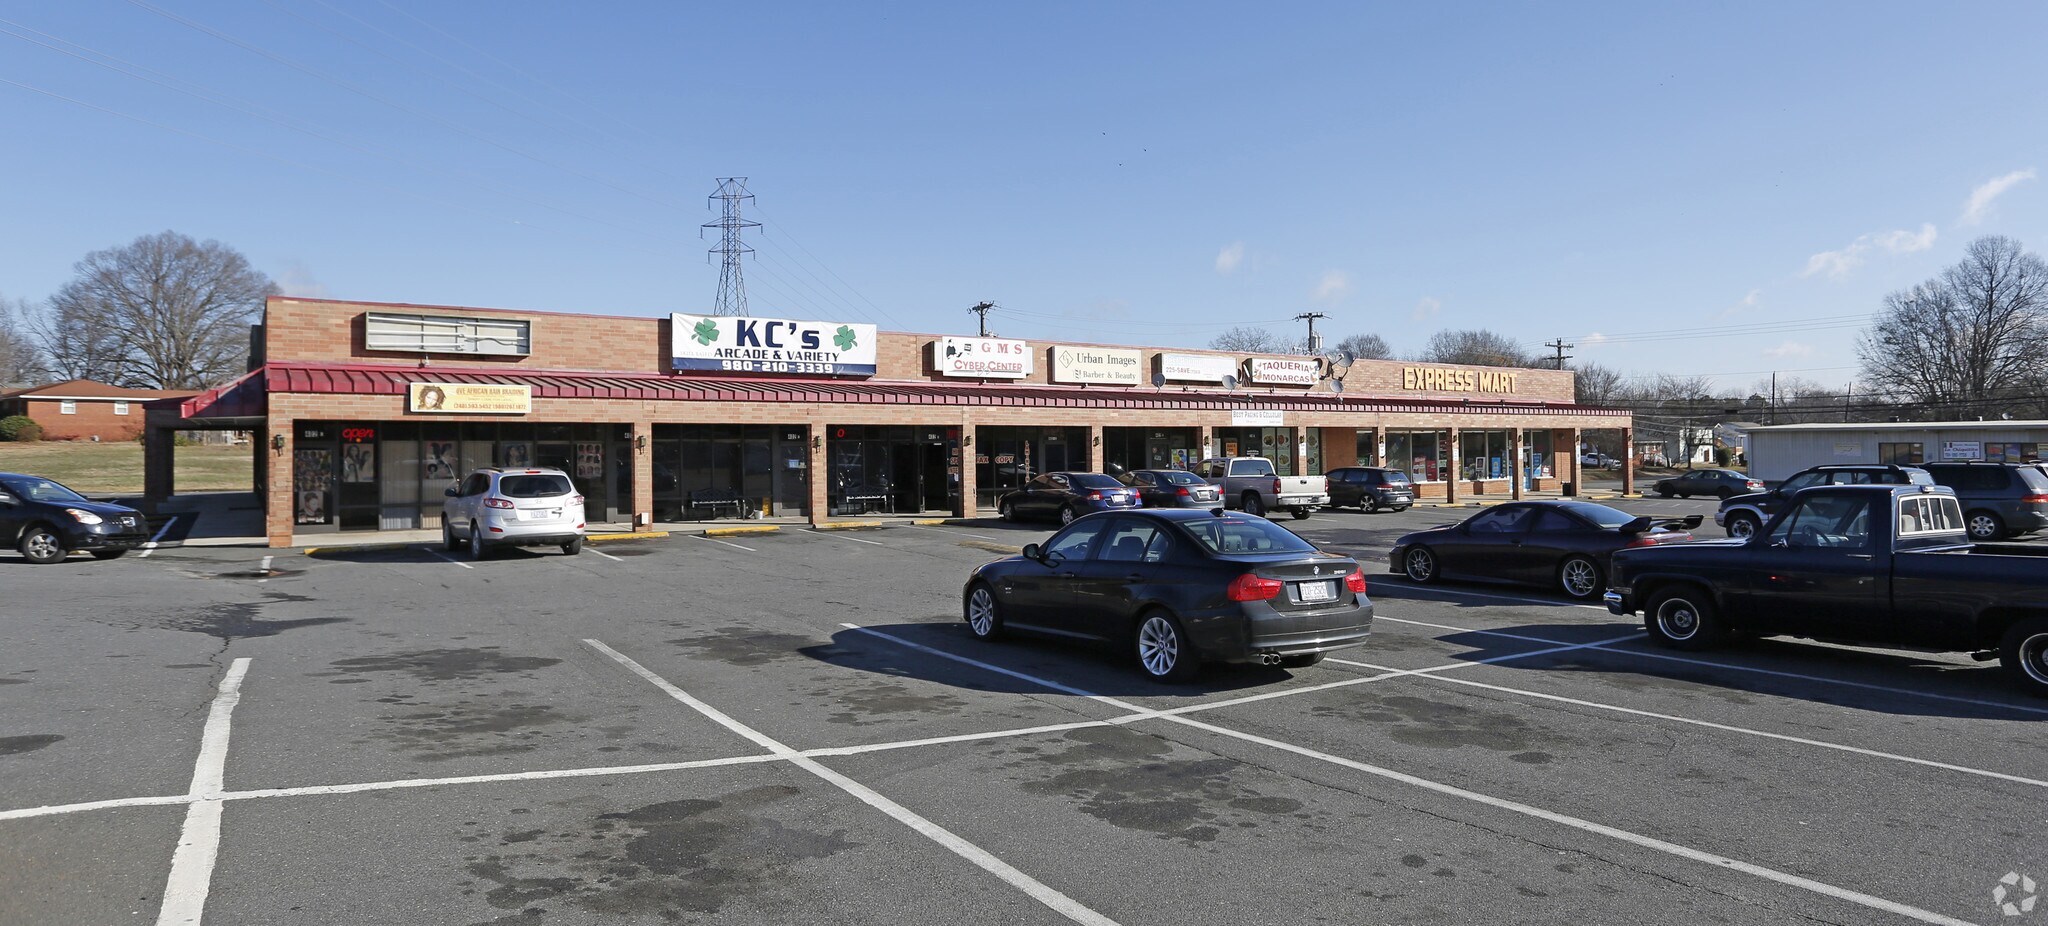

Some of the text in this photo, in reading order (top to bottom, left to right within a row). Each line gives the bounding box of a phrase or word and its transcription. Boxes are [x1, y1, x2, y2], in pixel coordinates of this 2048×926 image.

[736, 319, 820, 350] KC's
[714, 348, 840, 362] ARCADE & VARIETY
[1077, 353, 1137, 367] Urban Images
[722, 360, 833, 373] 980-210-3339
[954, 359, 1023, 371] CYBER CENTER
[1262, 361, 1310, 373] TAQUERIA
[1083, 371, 1104, 379] Barber
[1115, 372, 1136, 381] Beauty
[1262, 373, 1310, 383] MONARCAS
[1404, 367, 1518, 393] EXPRESS MART
[467, 388, 488, 396] AFRICAN
[342, 428, 375, 443] open
[994, 455, 1015, 464] COPY
